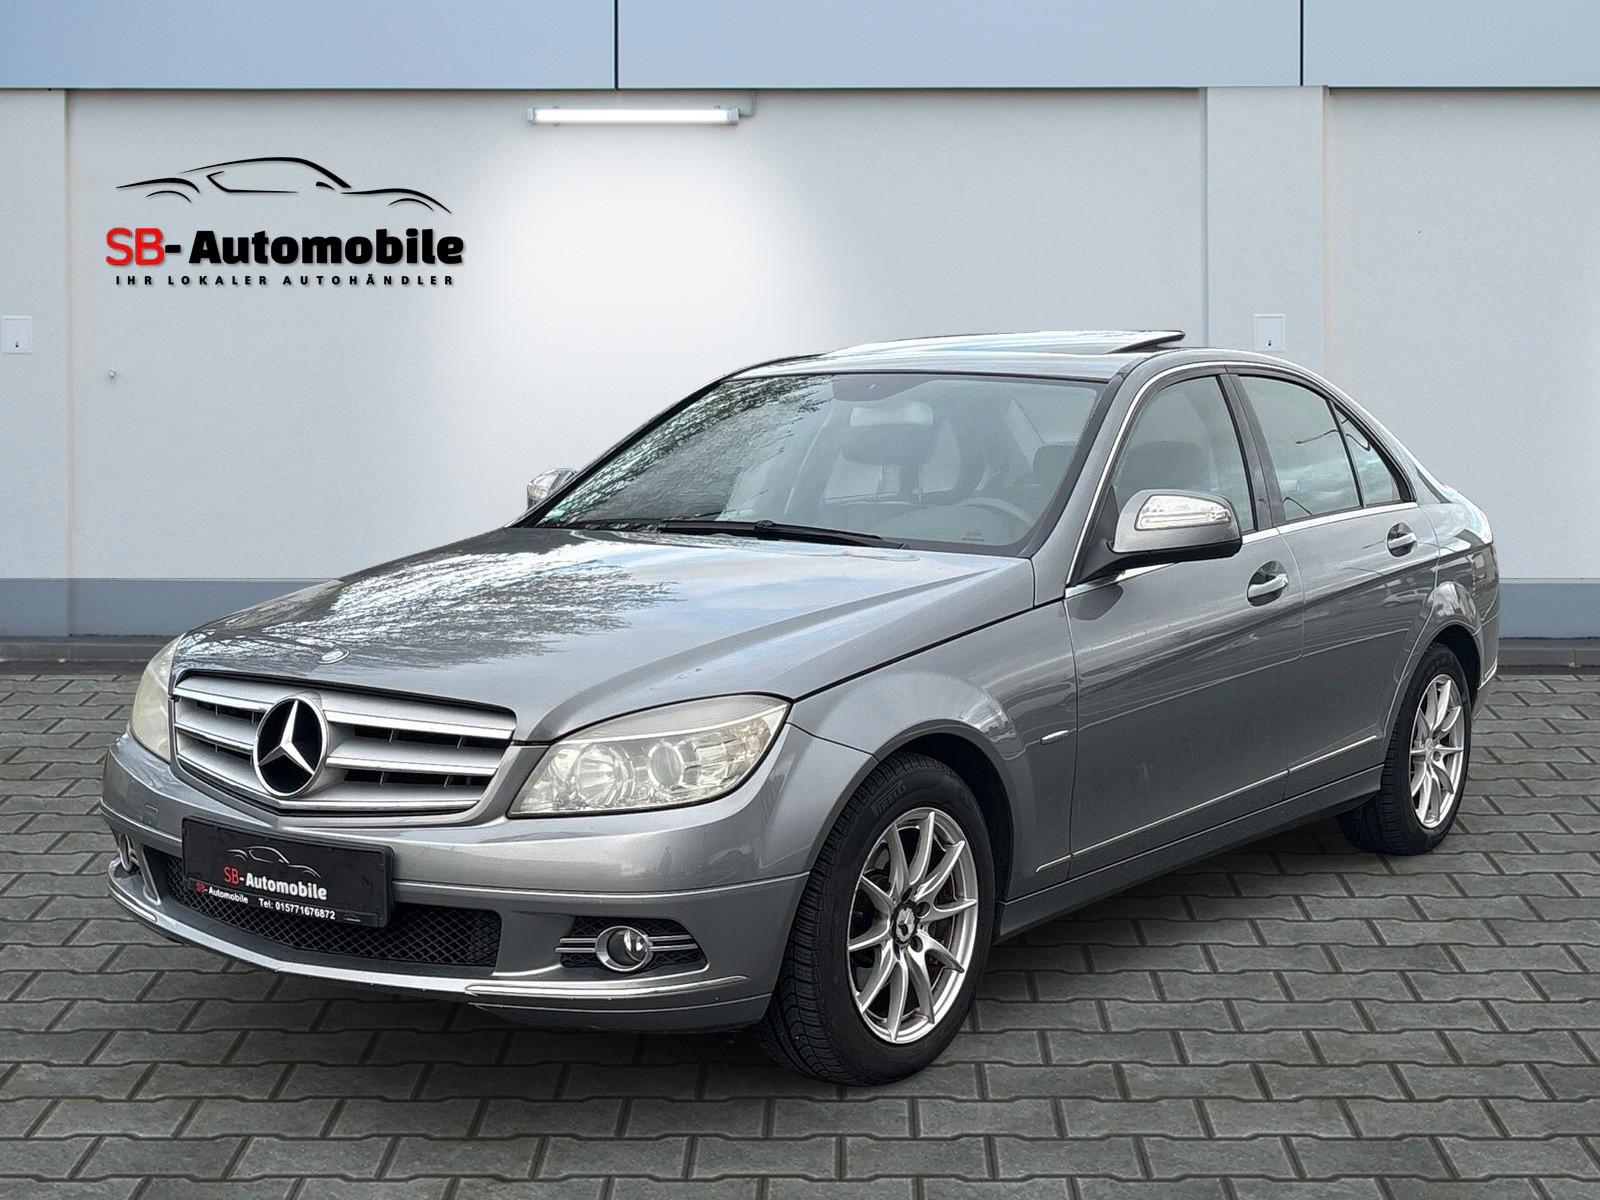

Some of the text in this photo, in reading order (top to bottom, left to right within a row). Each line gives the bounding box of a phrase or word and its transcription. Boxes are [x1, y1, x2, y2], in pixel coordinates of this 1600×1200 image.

[189, 228, 463, 264] Automobile
[117, 274, 452, 285] IHR LOKALER AUTOHÄNDLER
[208, 886, 249, 904] Automobile
[258, 897, 274, 910] Tel:
[275, 901, 336, 920] 015771676872
